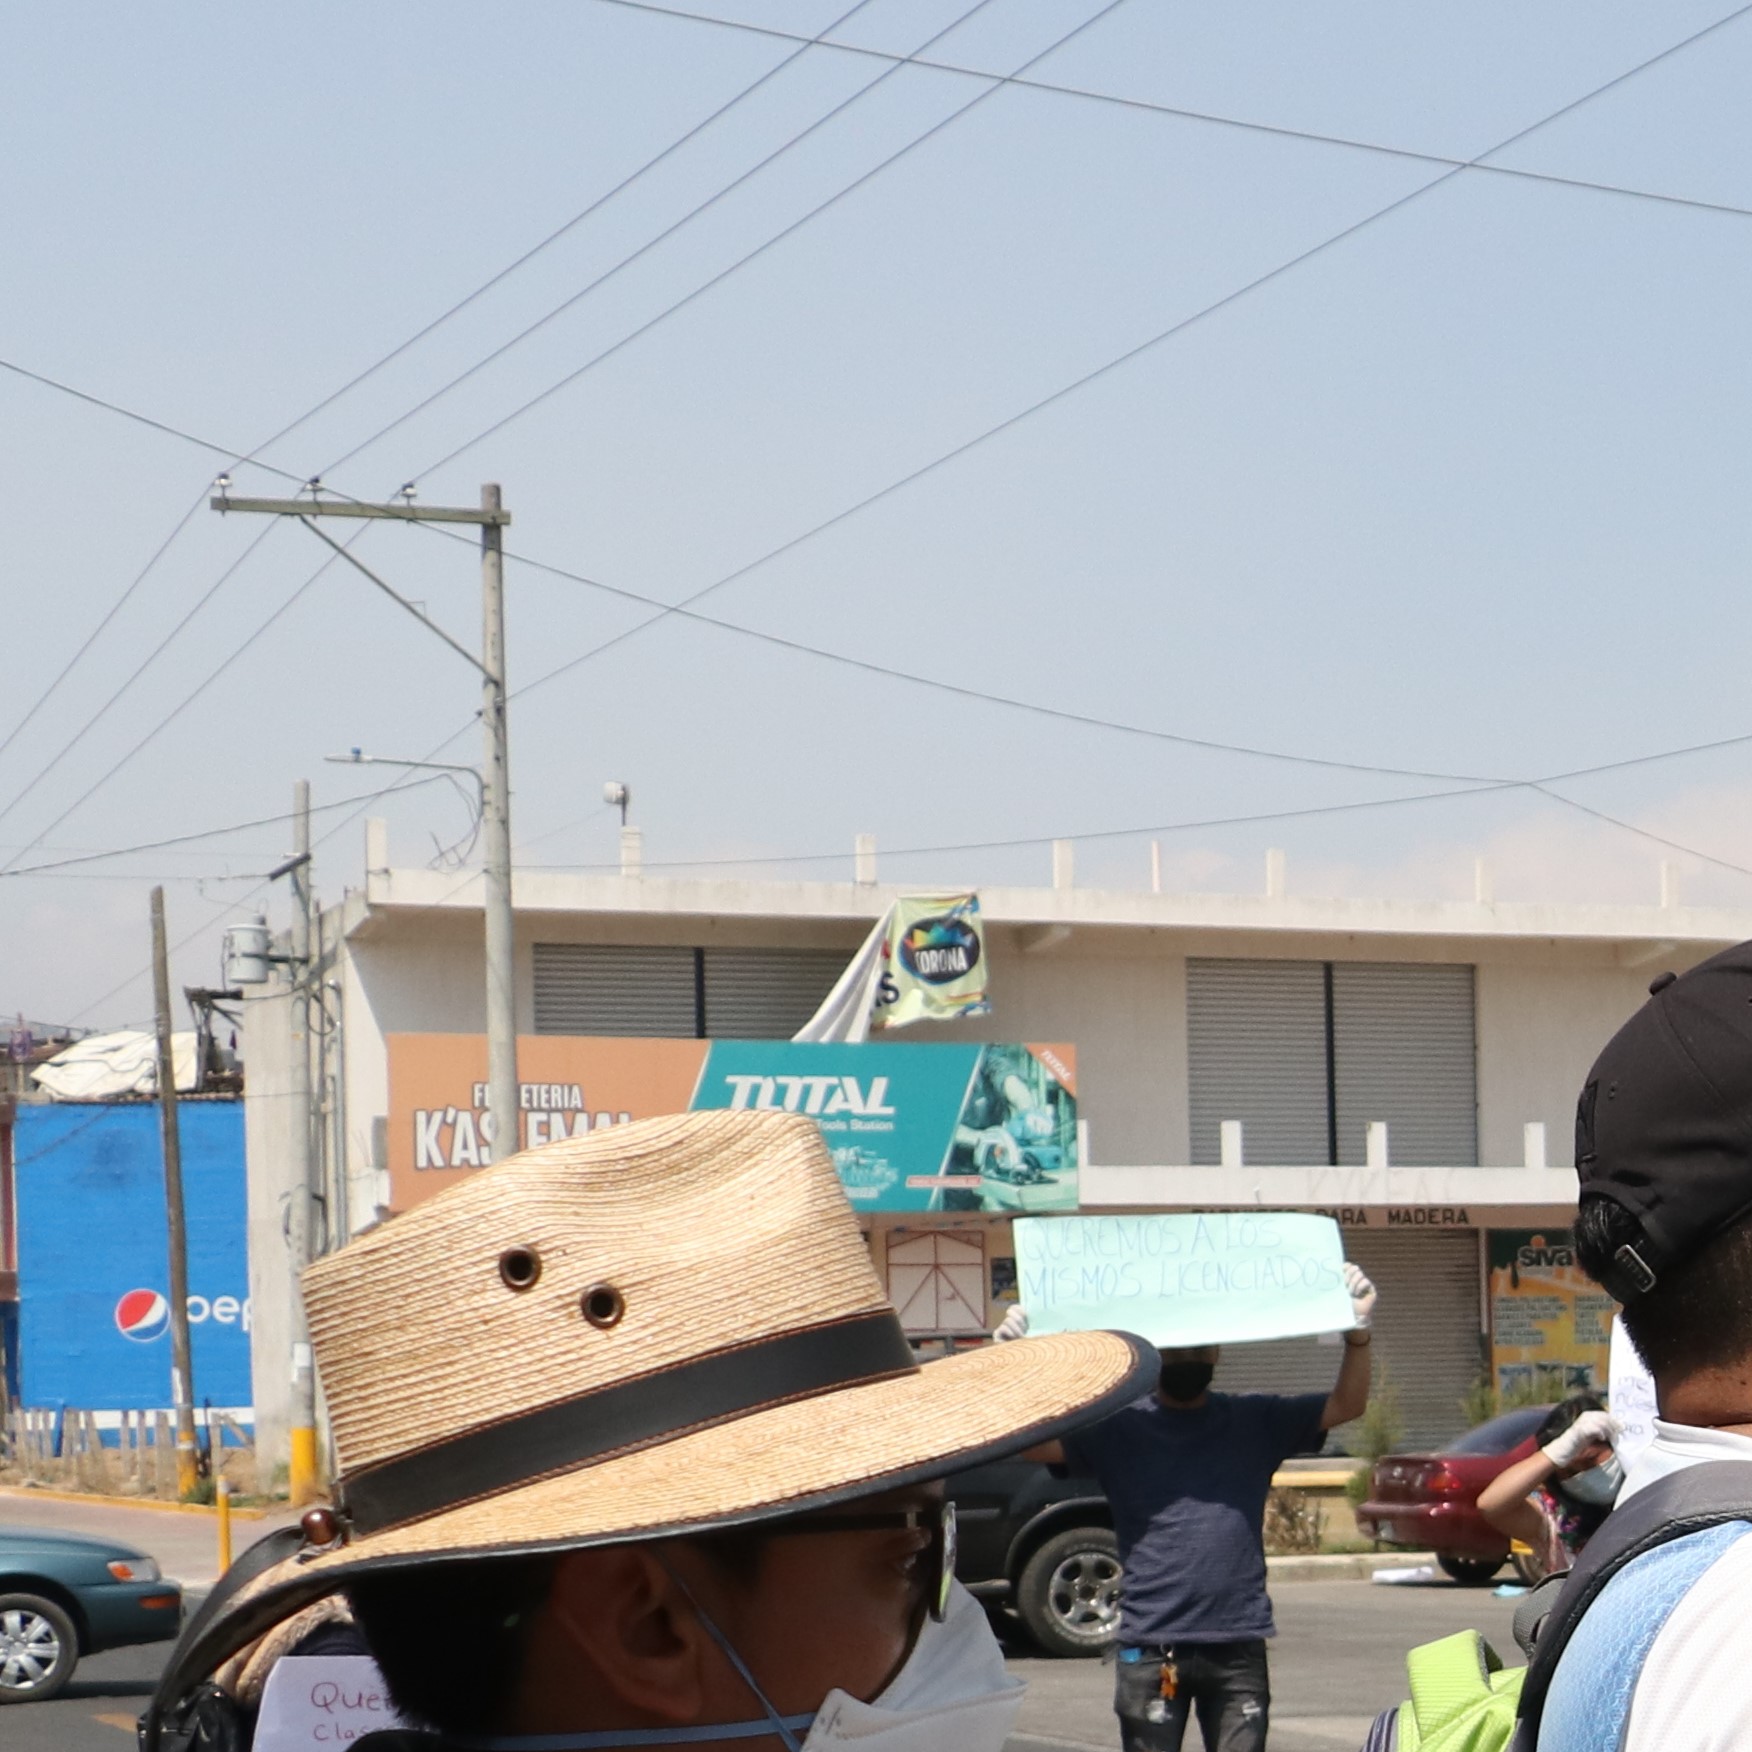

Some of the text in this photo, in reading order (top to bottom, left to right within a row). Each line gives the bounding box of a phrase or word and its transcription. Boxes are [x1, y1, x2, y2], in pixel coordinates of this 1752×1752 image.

[725, 1074, 896, 1116] TOTAL
[850, 1117, 895, 1131] Station
[1387, 1207, 1470, 1226] MADERA
[1022, 1214, 1283, 1262] QUEREMOS A LOS
[1023, 1253, 1343, 1311] MISMOS LICENCIADOS
